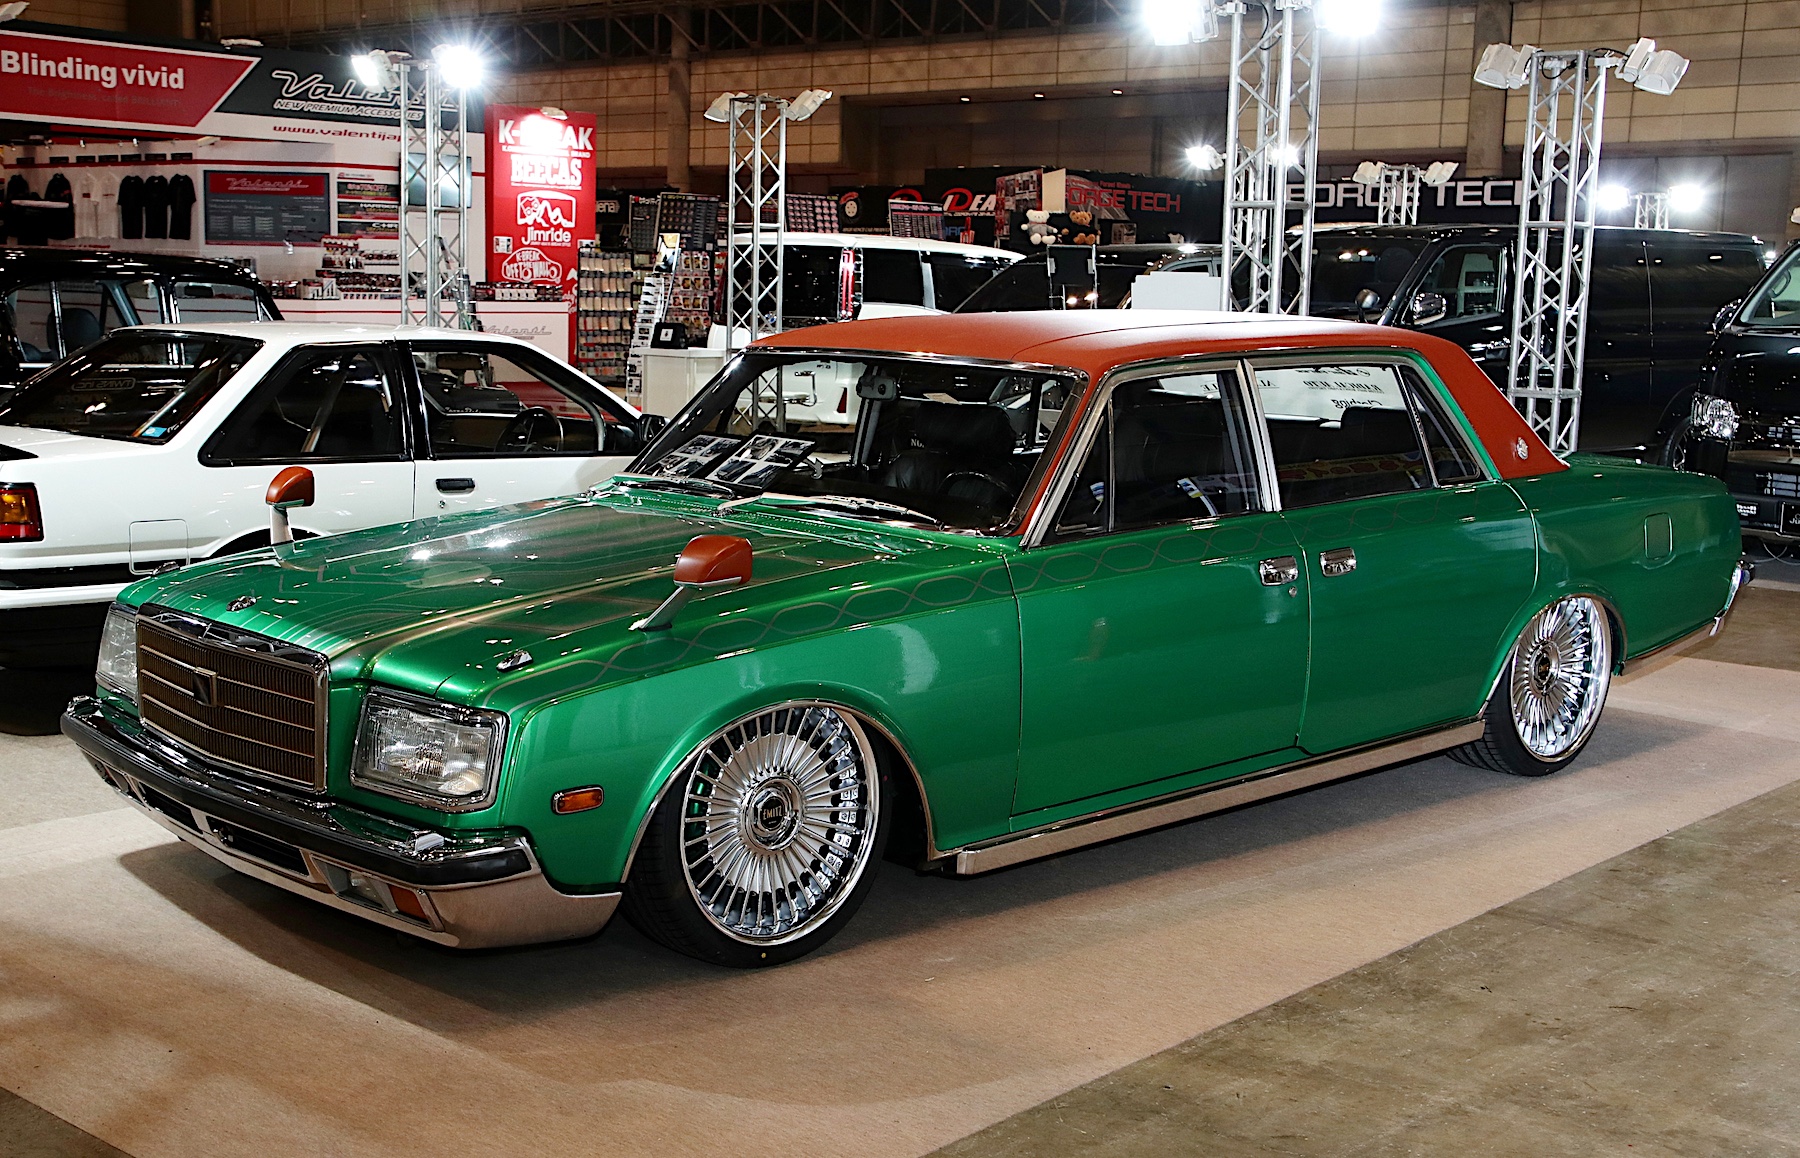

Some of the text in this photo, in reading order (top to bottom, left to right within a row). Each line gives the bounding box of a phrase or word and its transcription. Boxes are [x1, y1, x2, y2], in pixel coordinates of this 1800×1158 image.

[1, 50, 185, 89] Blinding vivid
[274, 99, 423, 120] NEW PREMIUM ACCESSOIES
[511, 153, 582, 187] BEECAS
[596, 201, 618, 213] ena
[941, 187, 997, 212] IDEA
[1066, 187, 1181, 213] ORGE TECH
[521, 226, 572, 246] Jimride
[515, 250, 541, 262] K-BREAK
